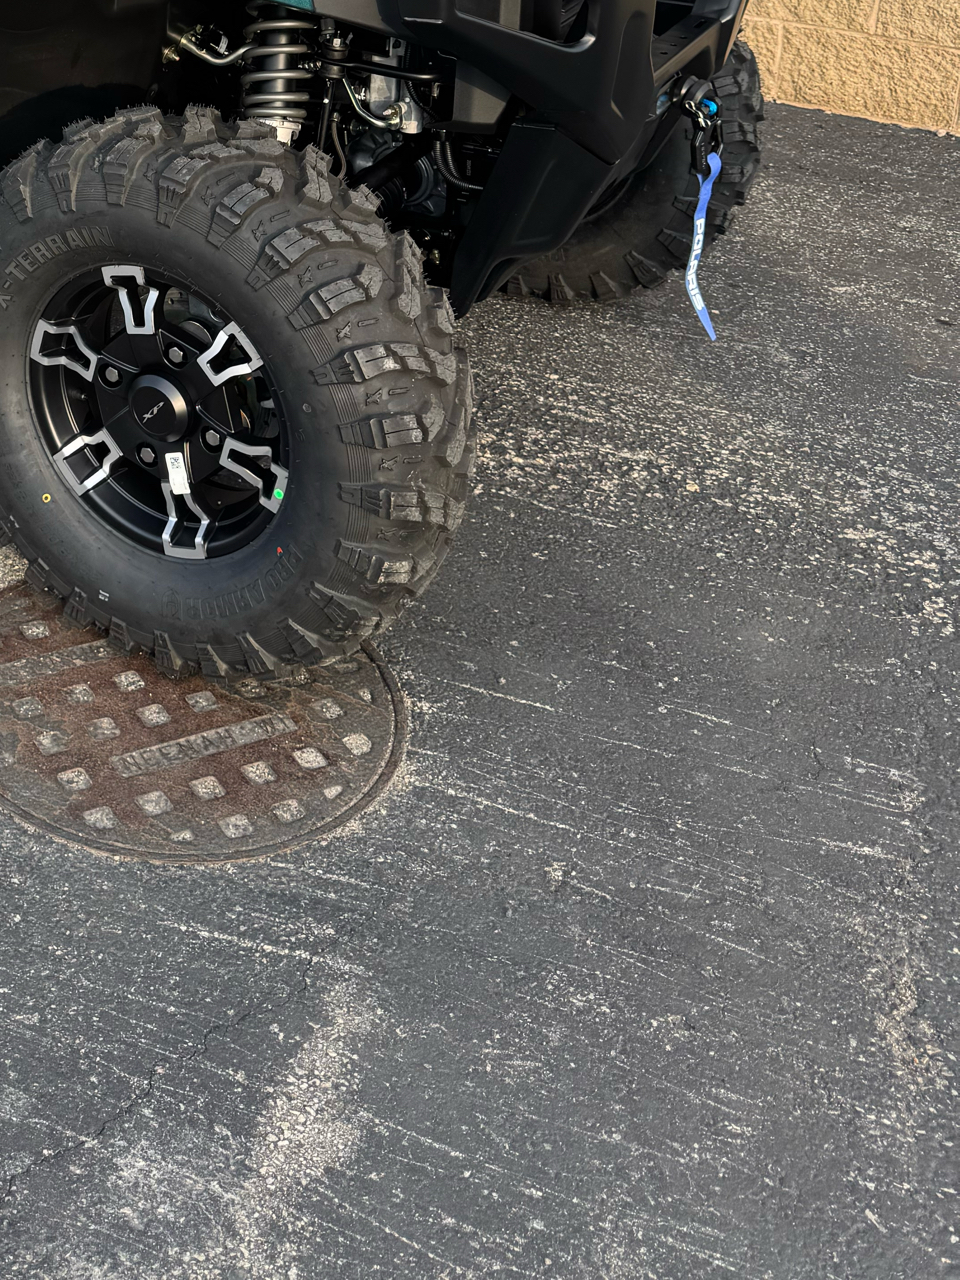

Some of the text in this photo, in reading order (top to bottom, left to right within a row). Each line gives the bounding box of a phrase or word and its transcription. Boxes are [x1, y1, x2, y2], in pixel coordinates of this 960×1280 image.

[686, 218, 706, 312] POLARIS
[142, 401, 165, 424] XP
[186, 543, 303, 619] PRO ARMOR
